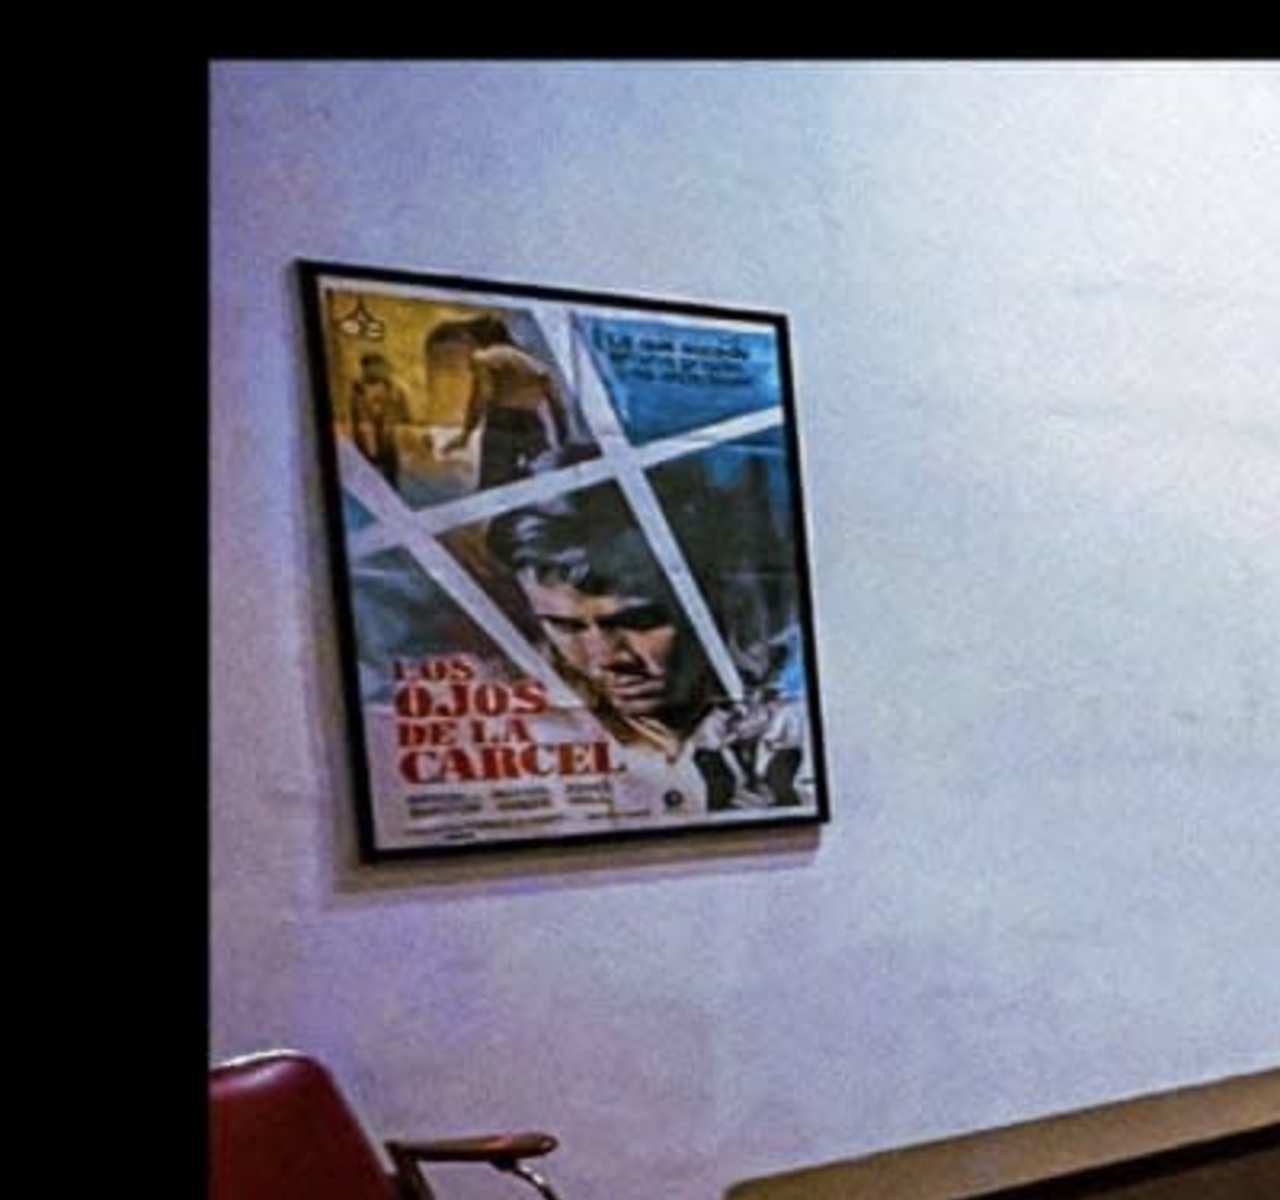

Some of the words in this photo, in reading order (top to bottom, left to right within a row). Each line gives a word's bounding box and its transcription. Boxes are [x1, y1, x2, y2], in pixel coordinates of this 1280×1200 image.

[393, 659, 474, 681] LOS
[395, 681, 549, 718] OJOS
[397, 721, 457, 747] DE
[471, 718, 532, 743] LA
[400, 742, 628, 784] CARCEL
